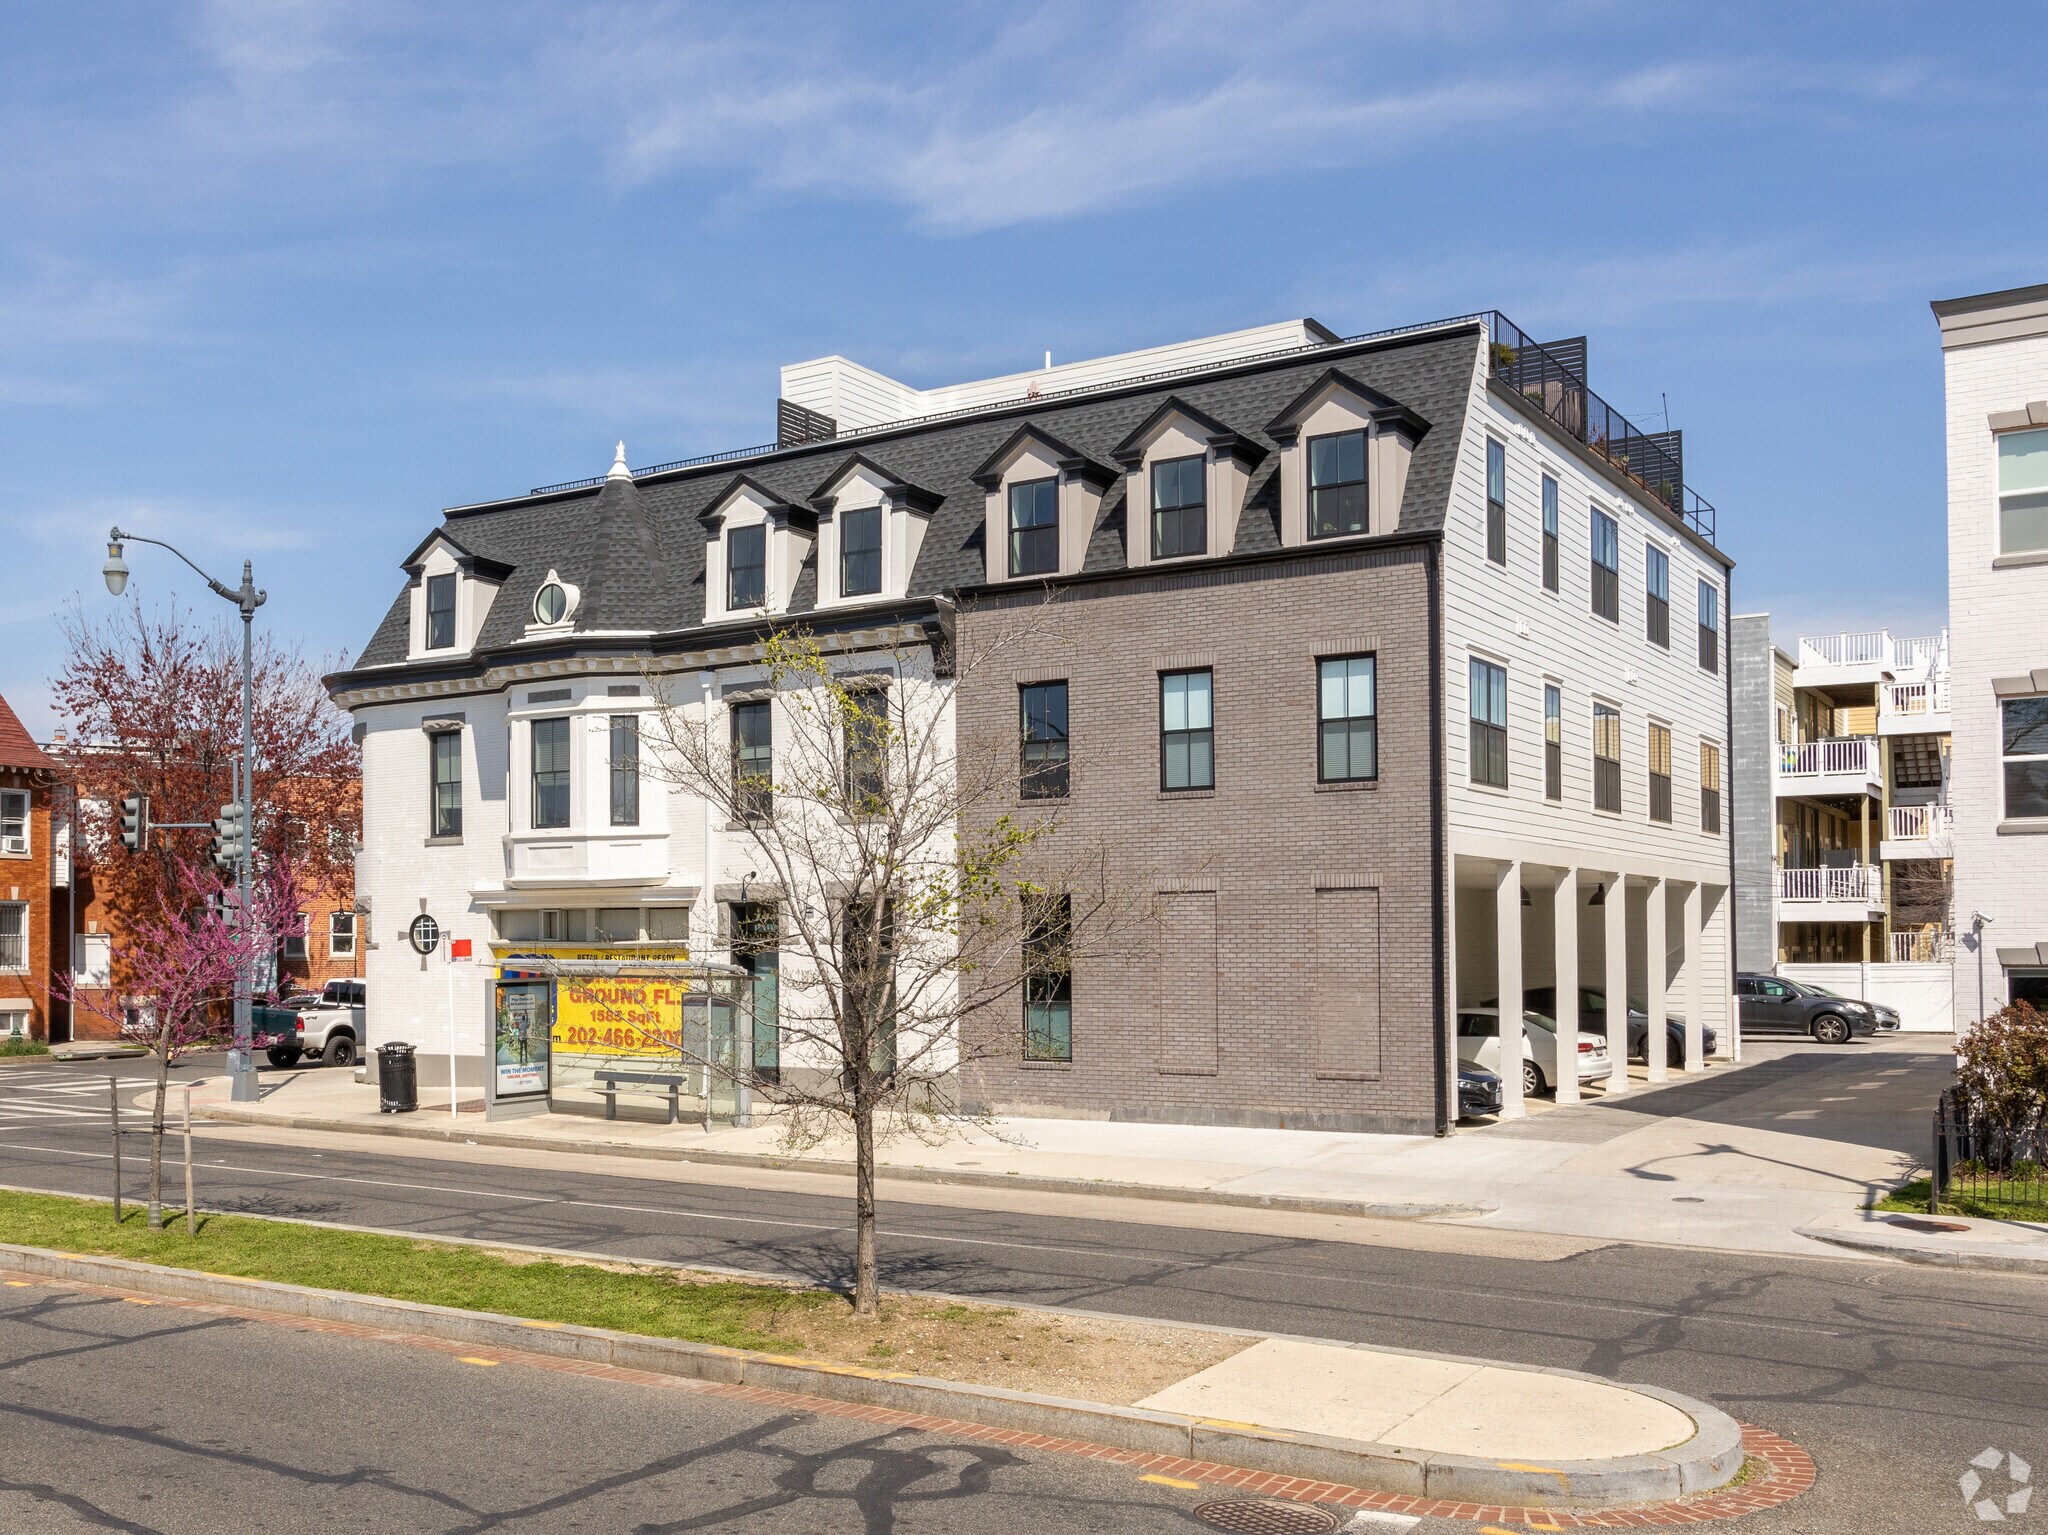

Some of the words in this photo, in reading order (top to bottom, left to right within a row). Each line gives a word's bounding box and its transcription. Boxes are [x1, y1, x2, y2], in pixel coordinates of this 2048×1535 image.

[569, 987, 647, 1004] GROUND
[653, 989, 681, 1005] FL.
[591, 1010, 623, 1021] 1585
